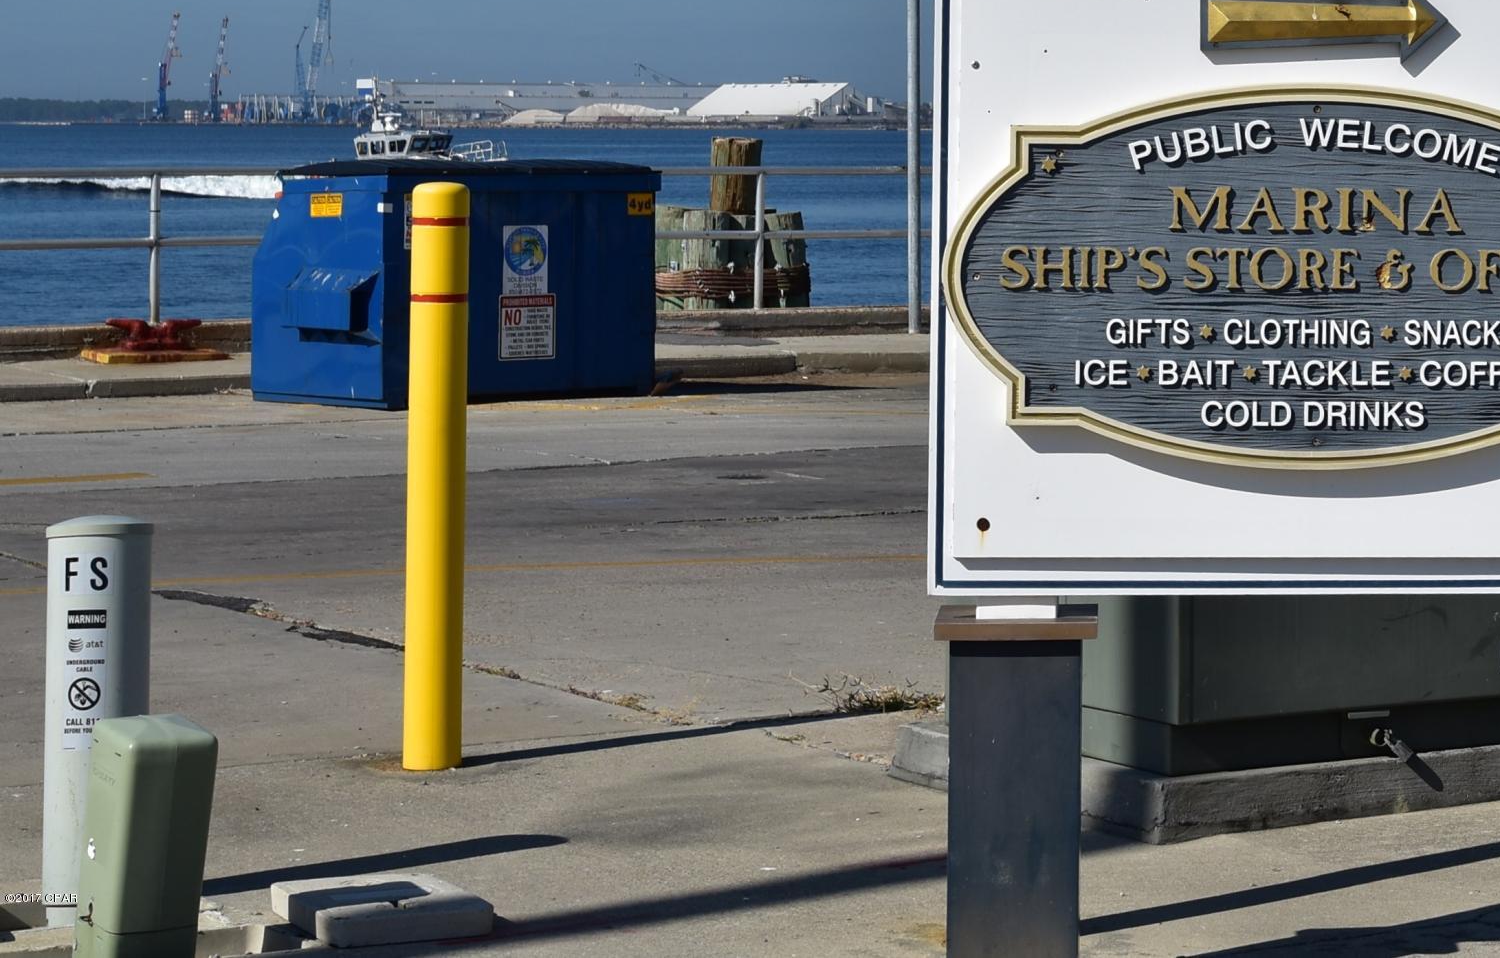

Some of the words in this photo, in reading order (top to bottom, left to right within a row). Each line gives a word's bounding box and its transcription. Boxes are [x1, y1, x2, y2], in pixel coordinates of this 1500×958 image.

[1128, 119, 1273, 171] PUBLIC
[629, 198, 652, 212] 4yd
[1169, 186, 1462, 233] MARINA
[1001, 246, 1168, 291] SHIP'S
[1184, 247, 1357, 291] STORE
[1374, 249, 1411, 291] &
[504, 309, 521, 325] NO
[1106, 319, 1190, 344] GIFTS
[1223, 318, 1370, 346] CLOTHING
[1075, 360, 1127, 385] ICE
[1158, 360, 1234, 385] BAIT
[1263, 360, 1390, 386] TACKLE
[1201, 400, 1292, 427] COLD
[1304, 401, 1424, 427] DRINKS
[65, 557, 79, 592] F
[90, 557, 109, 591] S
[68, 614, 106, 624] WARNING
[66, 718, 84, 726] CALL
[86, 718, 100, 726] 81
